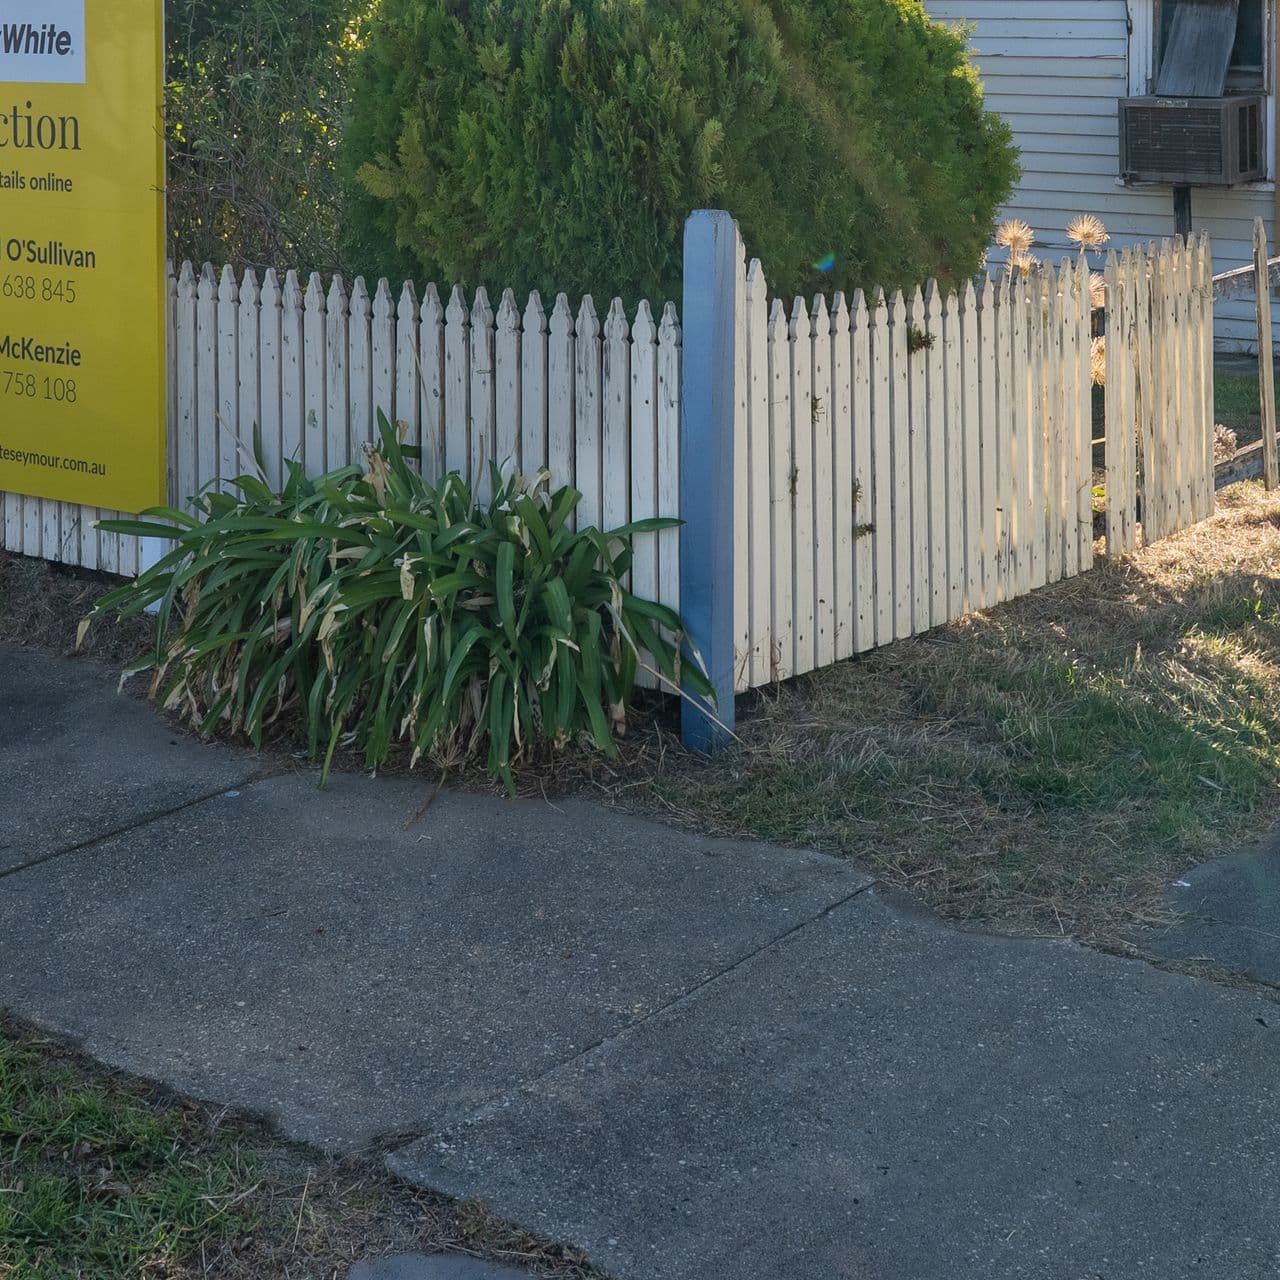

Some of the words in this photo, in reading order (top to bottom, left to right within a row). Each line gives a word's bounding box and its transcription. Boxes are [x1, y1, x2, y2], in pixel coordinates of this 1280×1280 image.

[30, 172, 73, 193] online
[6, 238, 96, 268] O'Sullivan
[2, 274, 36, 300] 638
[41, 277, 76, 303] 845
[3, 371, 36, 397] 758
[43, 377, 77, 403] 108
